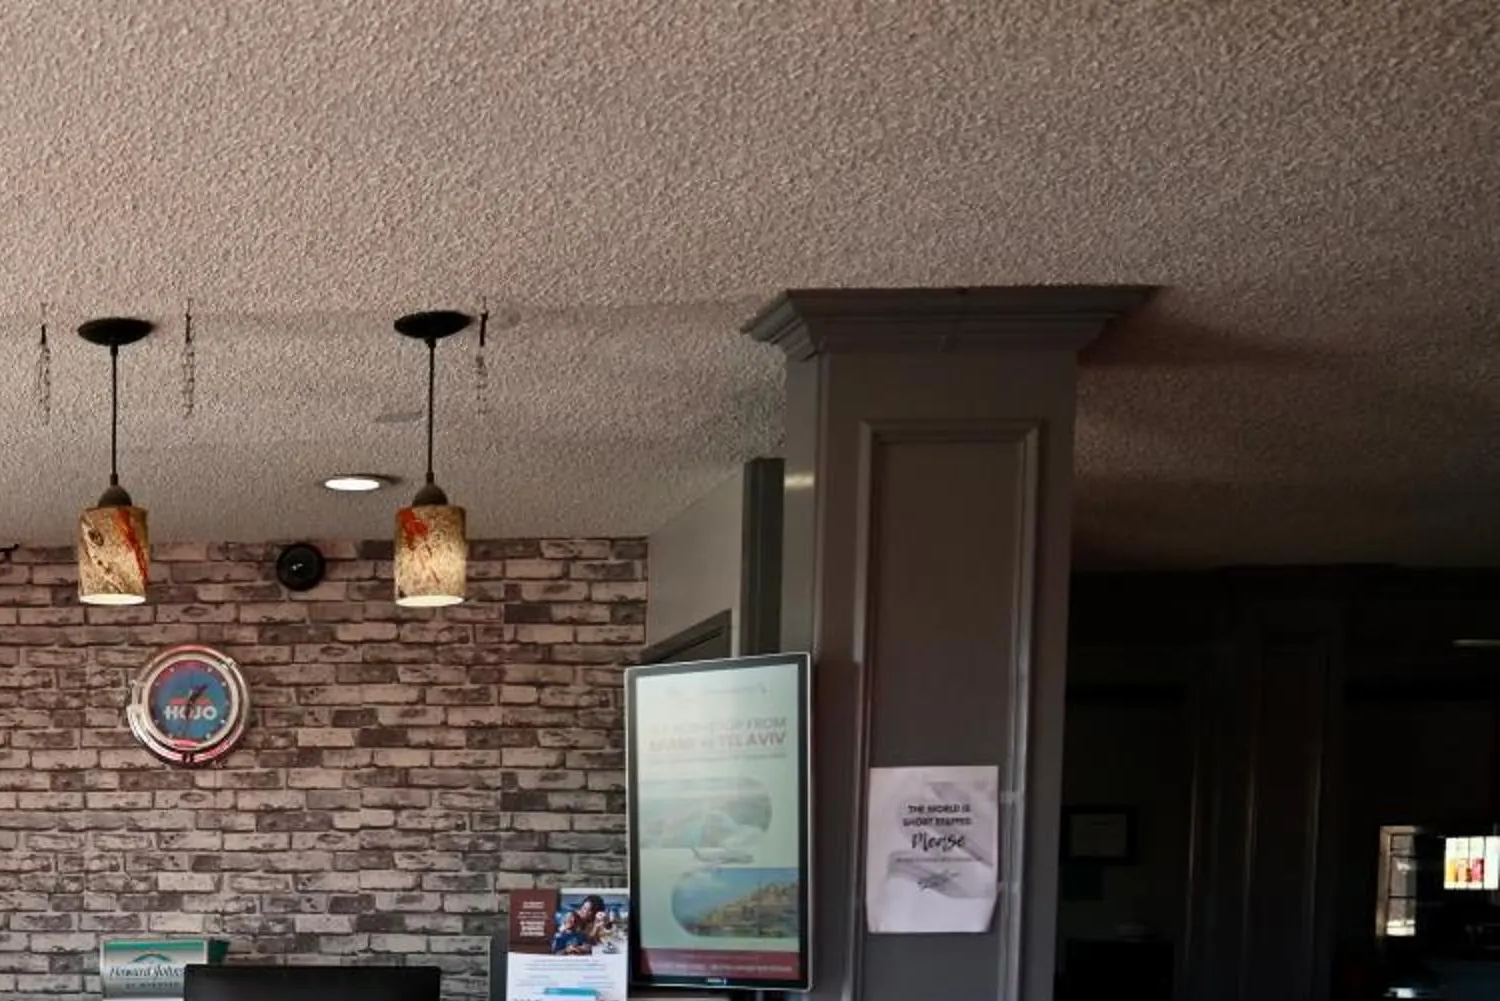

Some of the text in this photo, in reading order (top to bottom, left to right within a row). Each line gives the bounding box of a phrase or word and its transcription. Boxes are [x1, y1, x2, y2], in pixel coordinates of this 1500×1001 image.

[744, 731, 787, 747] AVIV
[907, 804, 972, 812] THE WORLD IS
[902, 817, 933, 827] SHORT
[911, 831, 966, 853] Please
